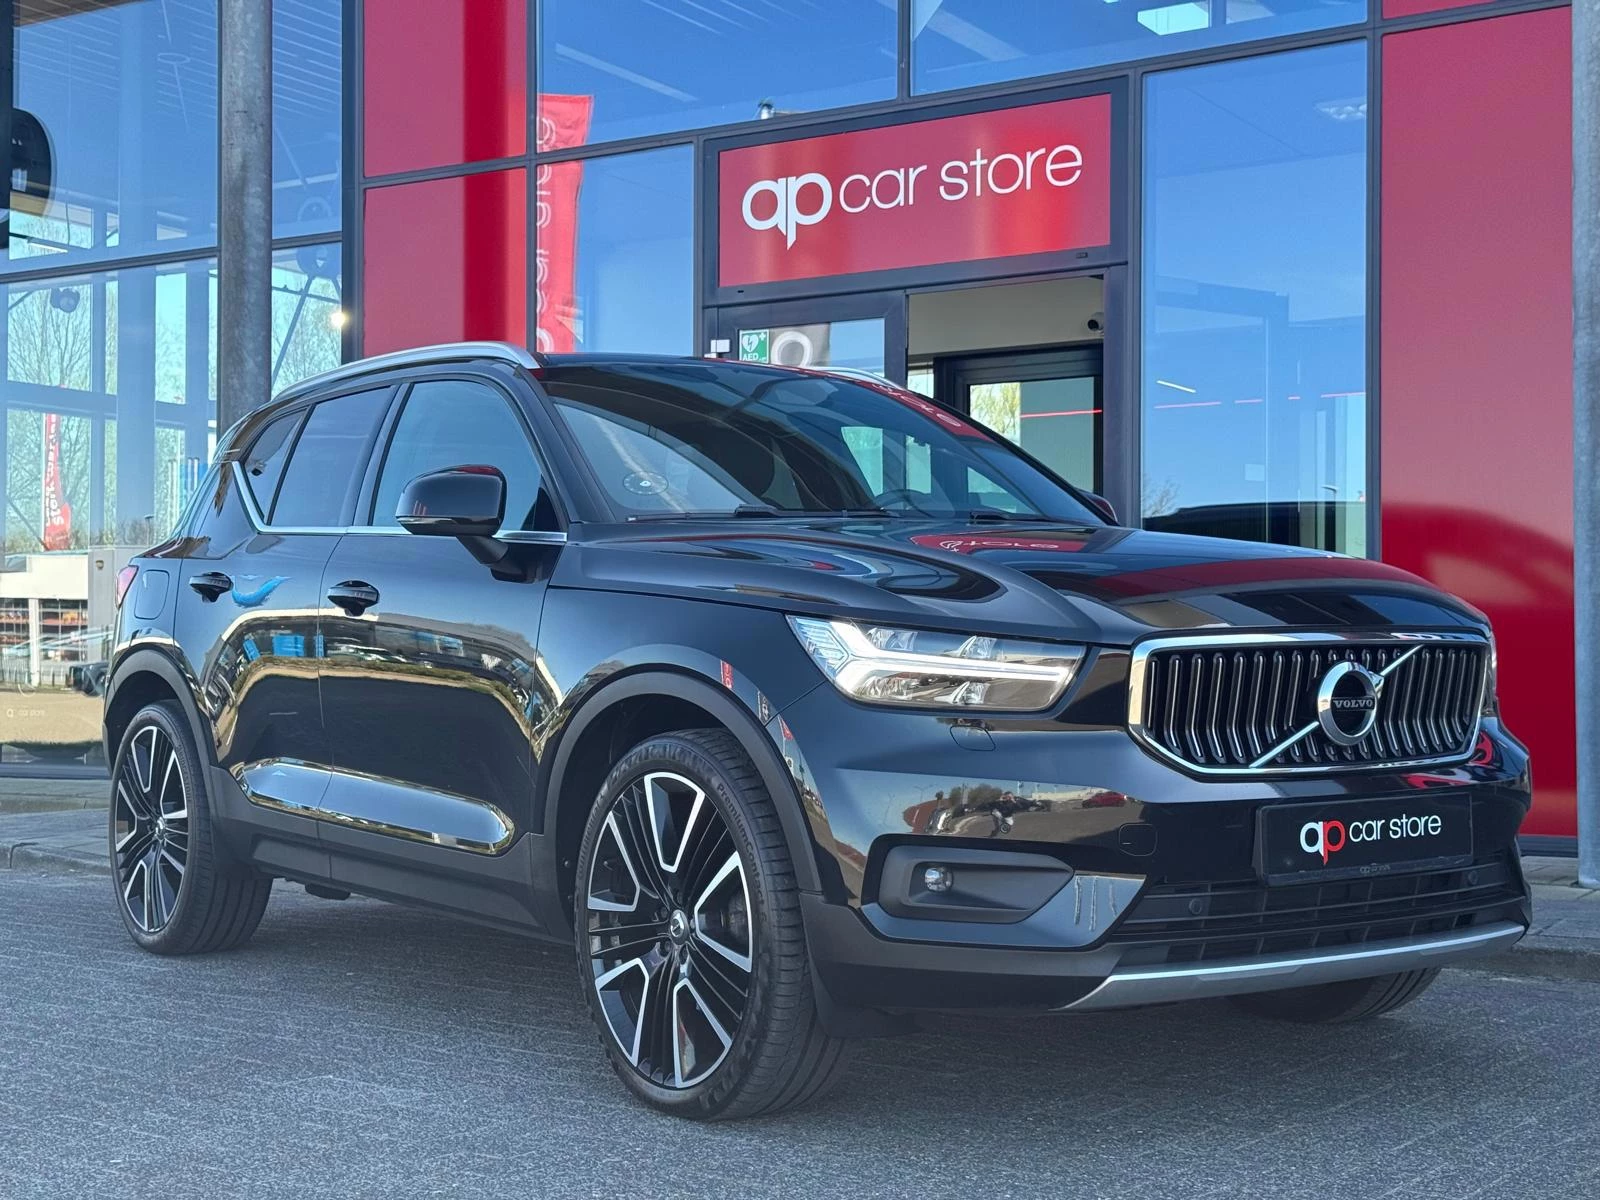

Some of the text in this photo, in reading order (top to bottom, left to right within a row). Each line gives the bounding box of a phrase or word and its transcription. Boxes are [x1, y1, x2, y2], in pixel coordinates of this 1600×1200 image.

[742, 144, 1083, 250] ap car store
[742, 352, 759, 362] AED
[1332, 698, 1374, 709] VOLVO
[1300, 813, 1442, 866] ap car store
